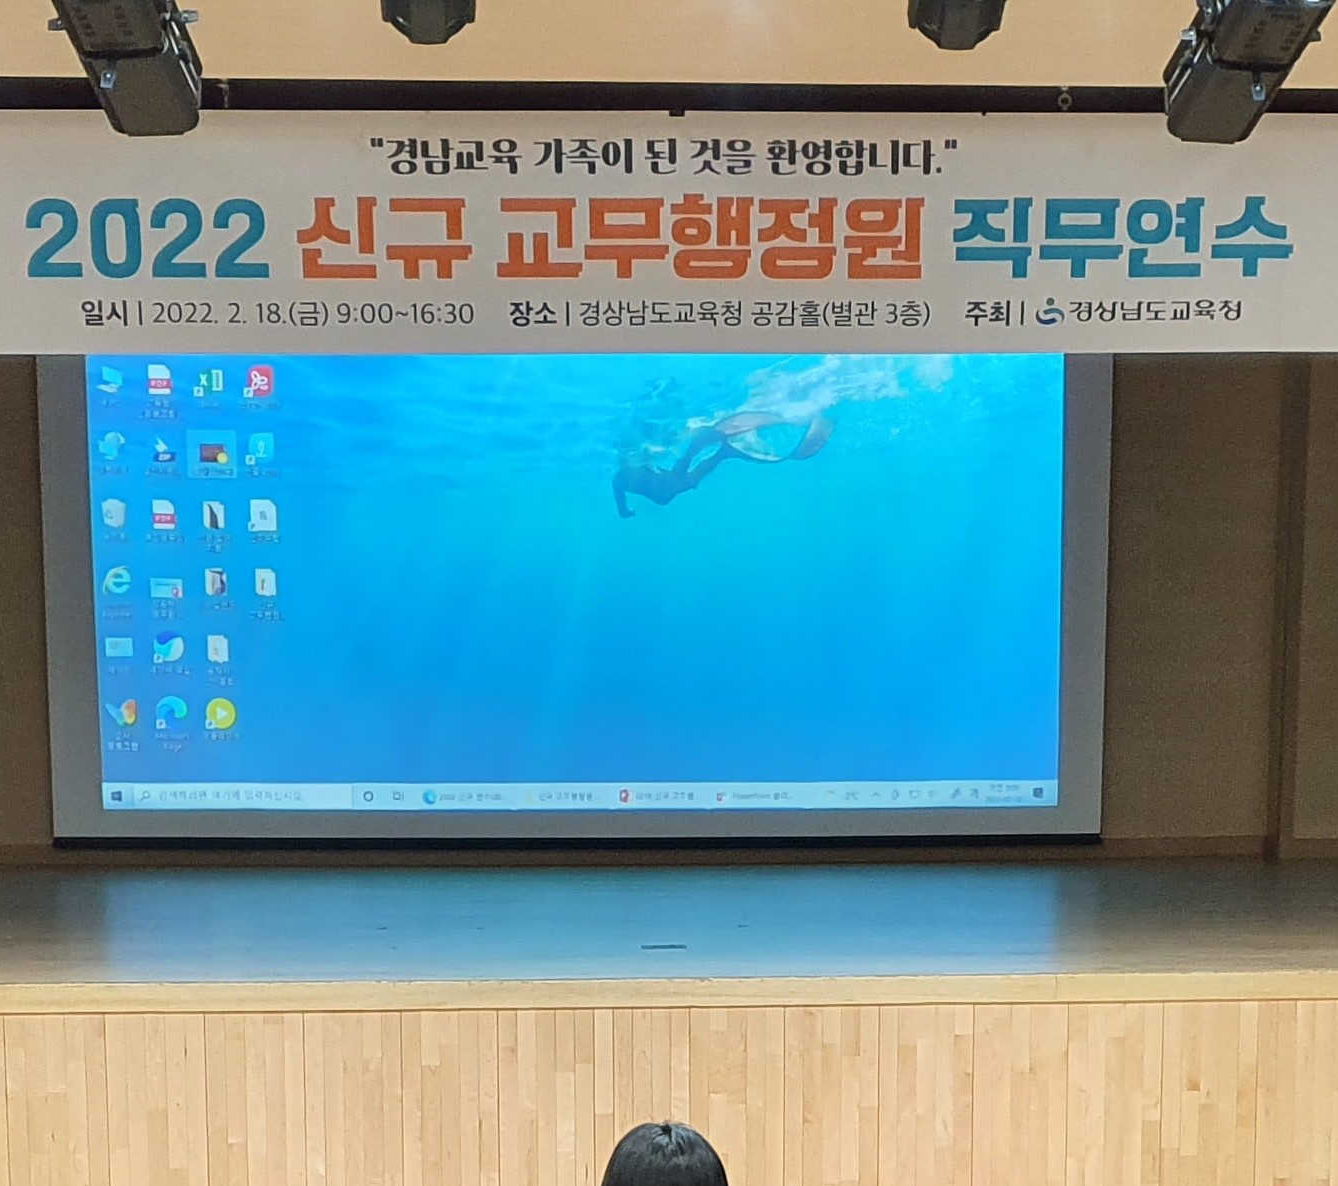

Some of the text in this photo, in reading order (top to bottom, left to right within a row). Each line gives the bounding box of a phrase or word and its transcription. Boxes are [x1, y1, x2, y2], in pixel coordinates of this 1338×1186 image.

[369, 137, 958, 177] "경남교육 가족이 된 것을 환영합니다."
[25, 192, 1294, 281] 2022 신규 교무행정원 직무연수
[80, 299, 475, 328] 일시 2022. 2. 18.(금) 9:00~16:30
[509, 299, 932, 328] 장소 경상남도교육청 공감홀(별관 3층)
[964, 299, 1242, 328] 주최 경상남도교육청
